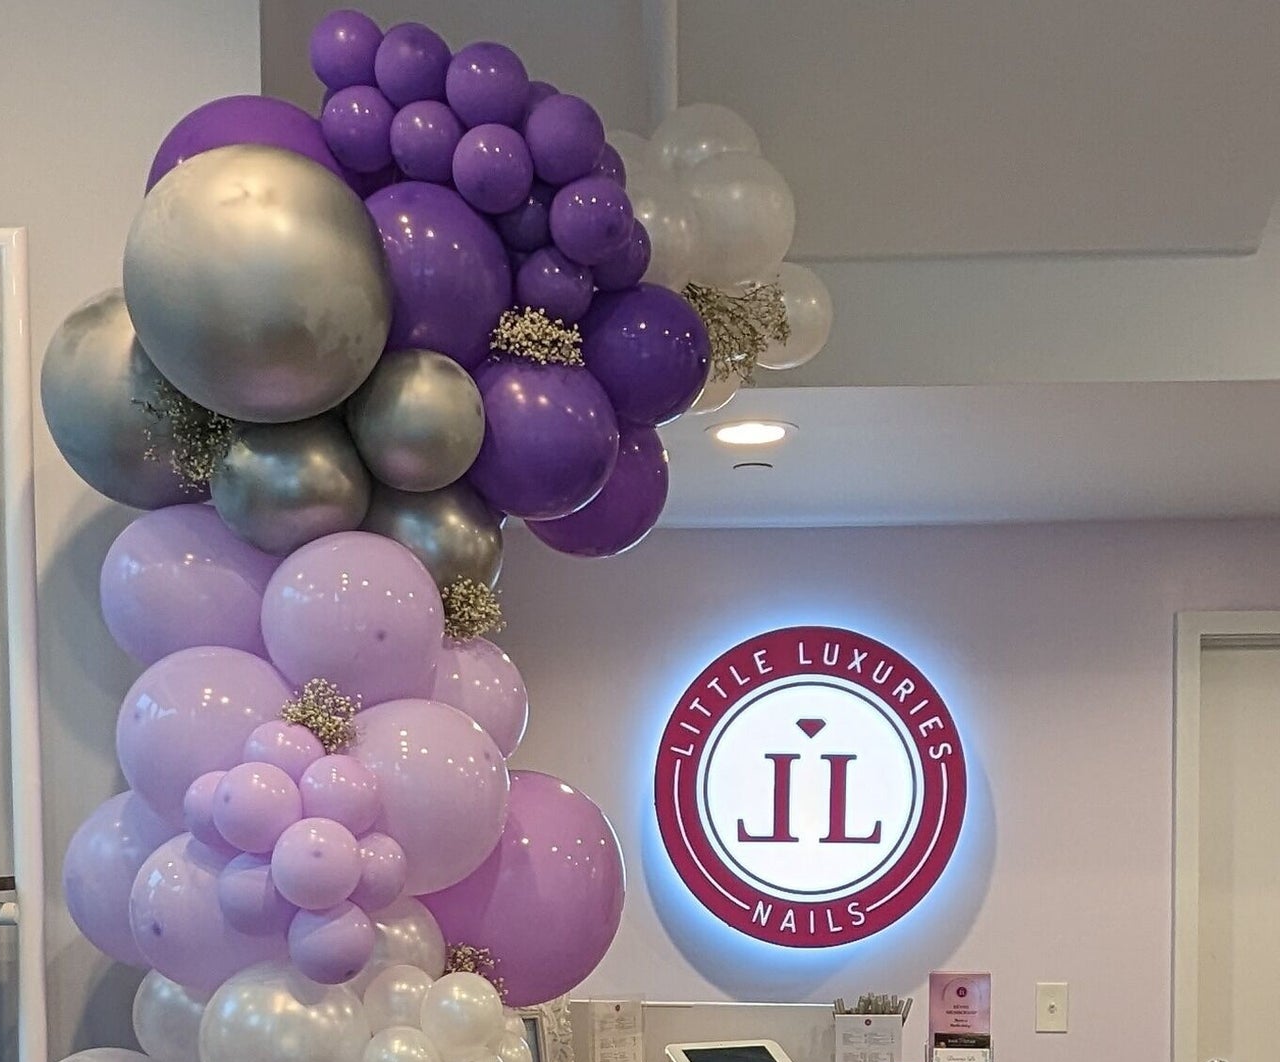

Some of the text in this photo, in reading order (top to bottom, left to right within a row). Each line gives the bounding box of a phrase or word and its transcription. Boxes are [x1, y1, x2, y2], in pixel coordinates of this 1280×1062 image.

[671, 642, 952, 760] LITTLE LUXURIES
[752, 900, 865, 933] NAILS
